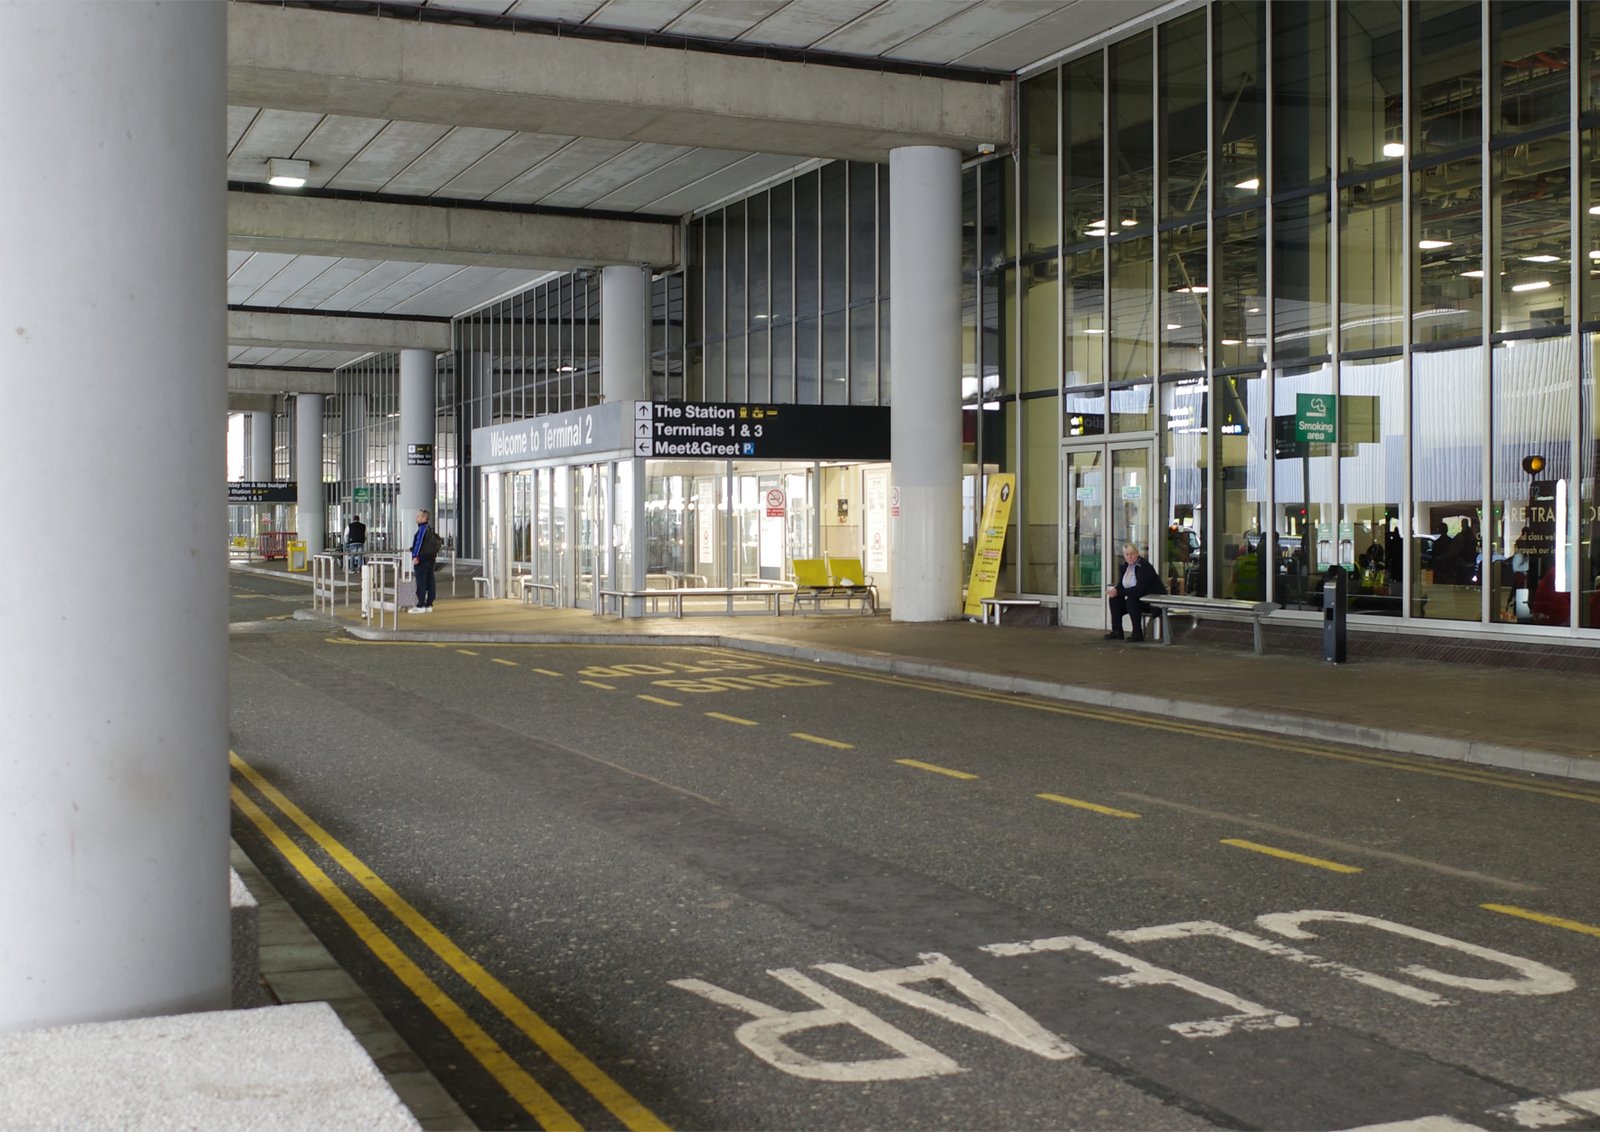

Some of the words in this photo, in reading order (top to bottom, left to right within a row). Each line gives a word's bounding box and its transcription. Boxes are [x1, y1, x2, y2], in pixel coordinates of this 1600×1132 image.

[654, 404, 682, 419] The
[685, 405, 735, 419] Station
[654, 423, 725, 437] Terminals
[729, 425, 735, 437] 1
[740, 425, 751, 437] &
[754, 425, 763, 437] 3
[1298, 421, 1333, 433] Smoking
[490, 429, 527, 457] Welcome
[530, 426, 540, 451] to
[542, 415, 582, 450] Terminal
[585, 414, 592, 445] 2
[1306, 432, 1325, 440] area
[655, 441, 740, 455] Meet&Greet
[577, 660, 765, 677] STOP
[651, 674, 834, 693] BUS
[667, 909, 1577, 1083] CLEAR
